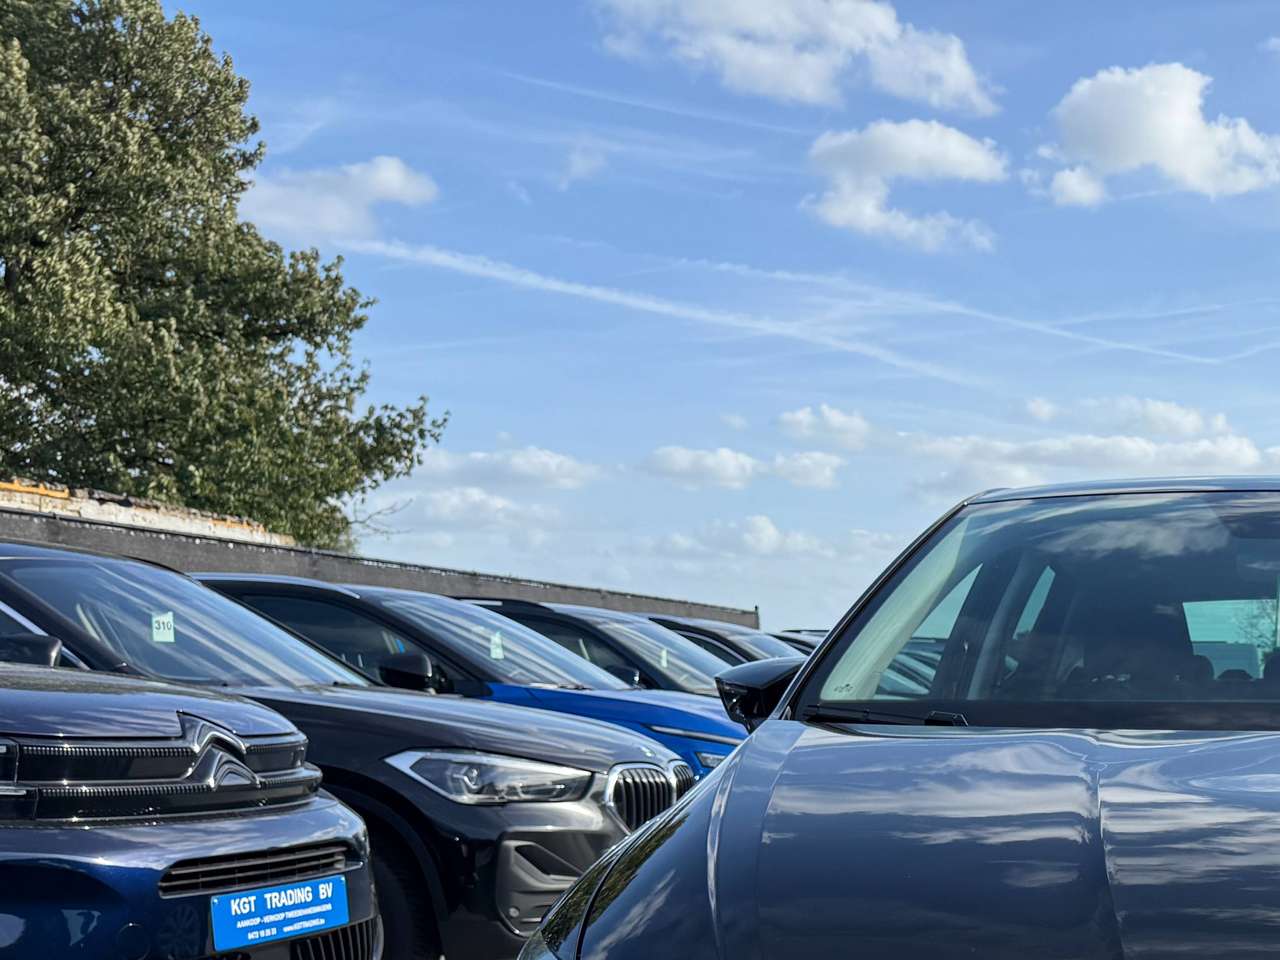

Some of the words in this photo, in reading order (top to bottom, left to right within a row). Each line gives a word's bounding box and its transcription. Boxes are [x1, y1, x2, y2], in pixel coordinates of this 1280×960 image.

[230, 896, 256, 916] KGT
[264, 886, 313, 909] TRADING
[318, 882, 333, 899] BV
